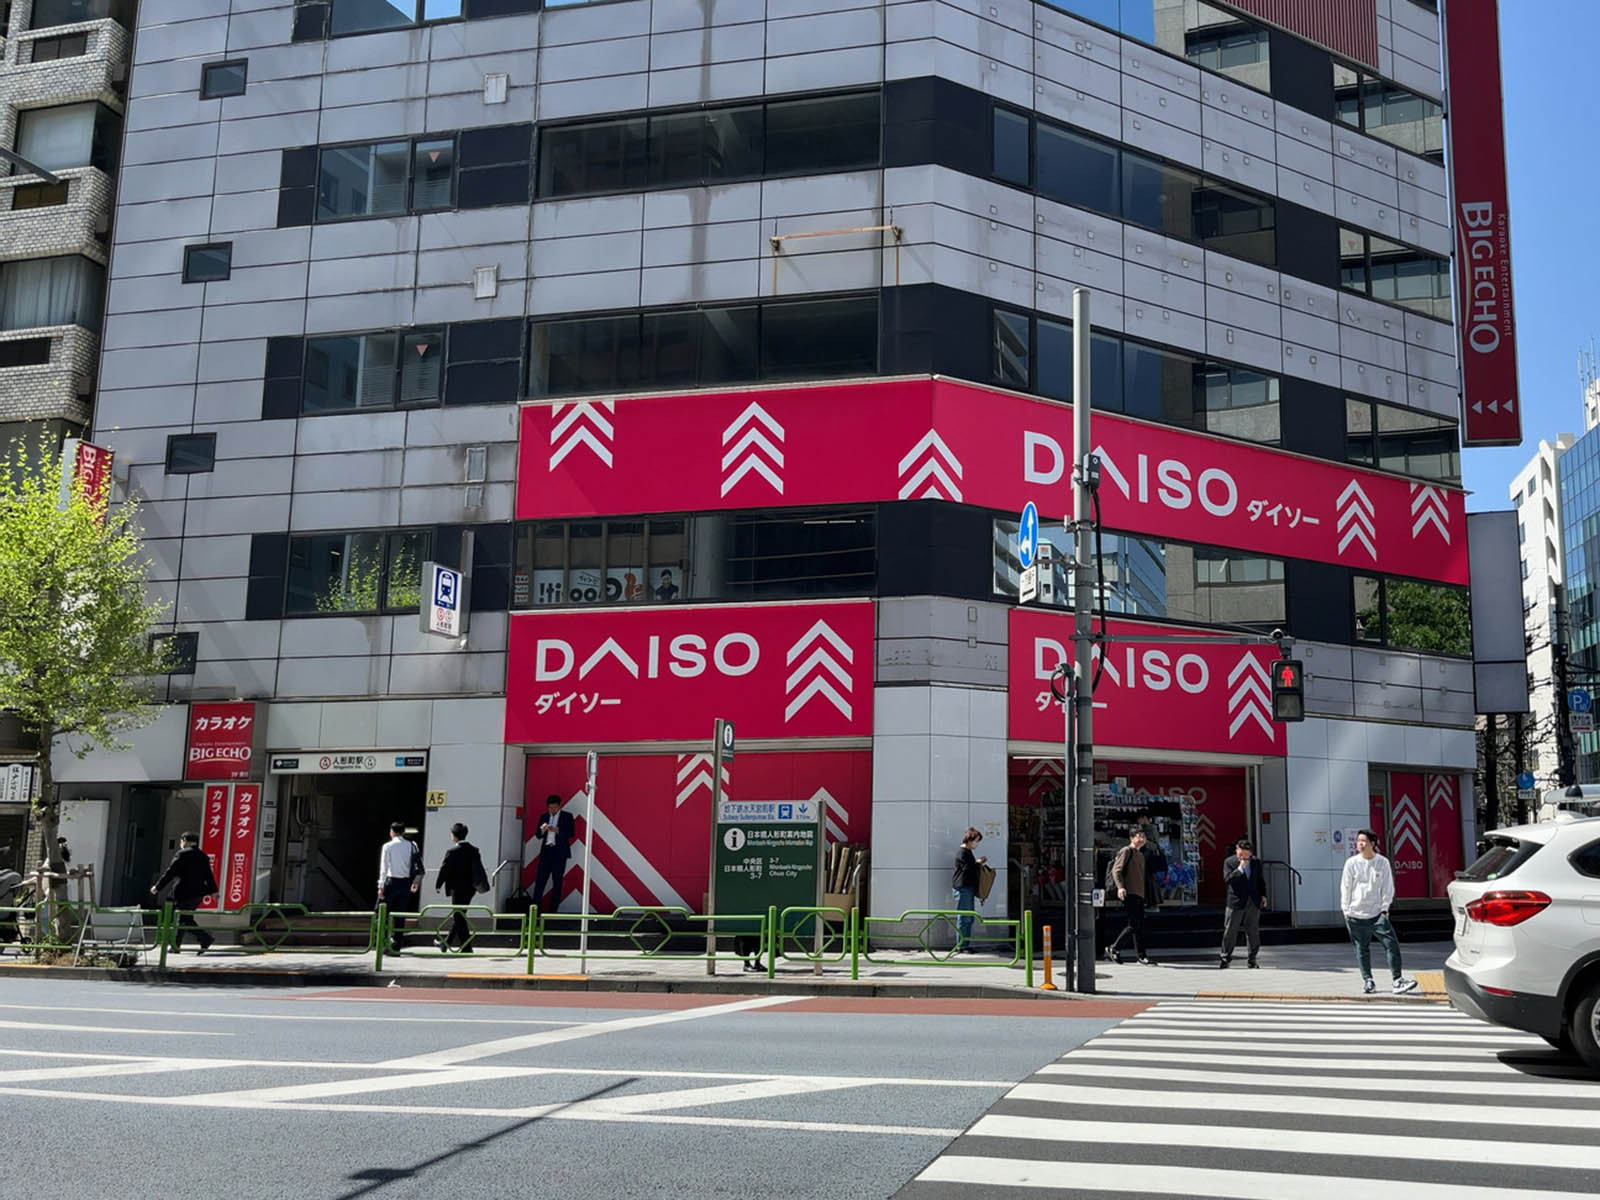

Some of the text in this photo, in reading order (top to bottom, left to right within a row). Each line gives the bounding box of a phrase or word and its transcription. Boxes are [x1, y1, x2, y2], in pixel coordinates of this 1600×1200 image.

[1461, 201, 1500, 354] BIG ECHO
[1498, 213, 1512, 336] Karaoke Entertainment
[1023, 430, 1238, 517] DAISO
[1246, 499, 1320, 529] ダイソー
[535, 632, 760, 681] DAISO
[1034, 637, 1209, 694] DAISO
[534, 691, 621, 715] ダイソー
[195, 715, 252, 731] カラオケ
[189, 746, 252, 761] BIG ECHO
[208, 790, 223, 838] カラオケ
[236, 792, 252, 839] カラオケ
[428, 792, 445, 805] A5
[234, 853, 245, 874] BIG
[1394, 860, 1424, 869] DAISO
